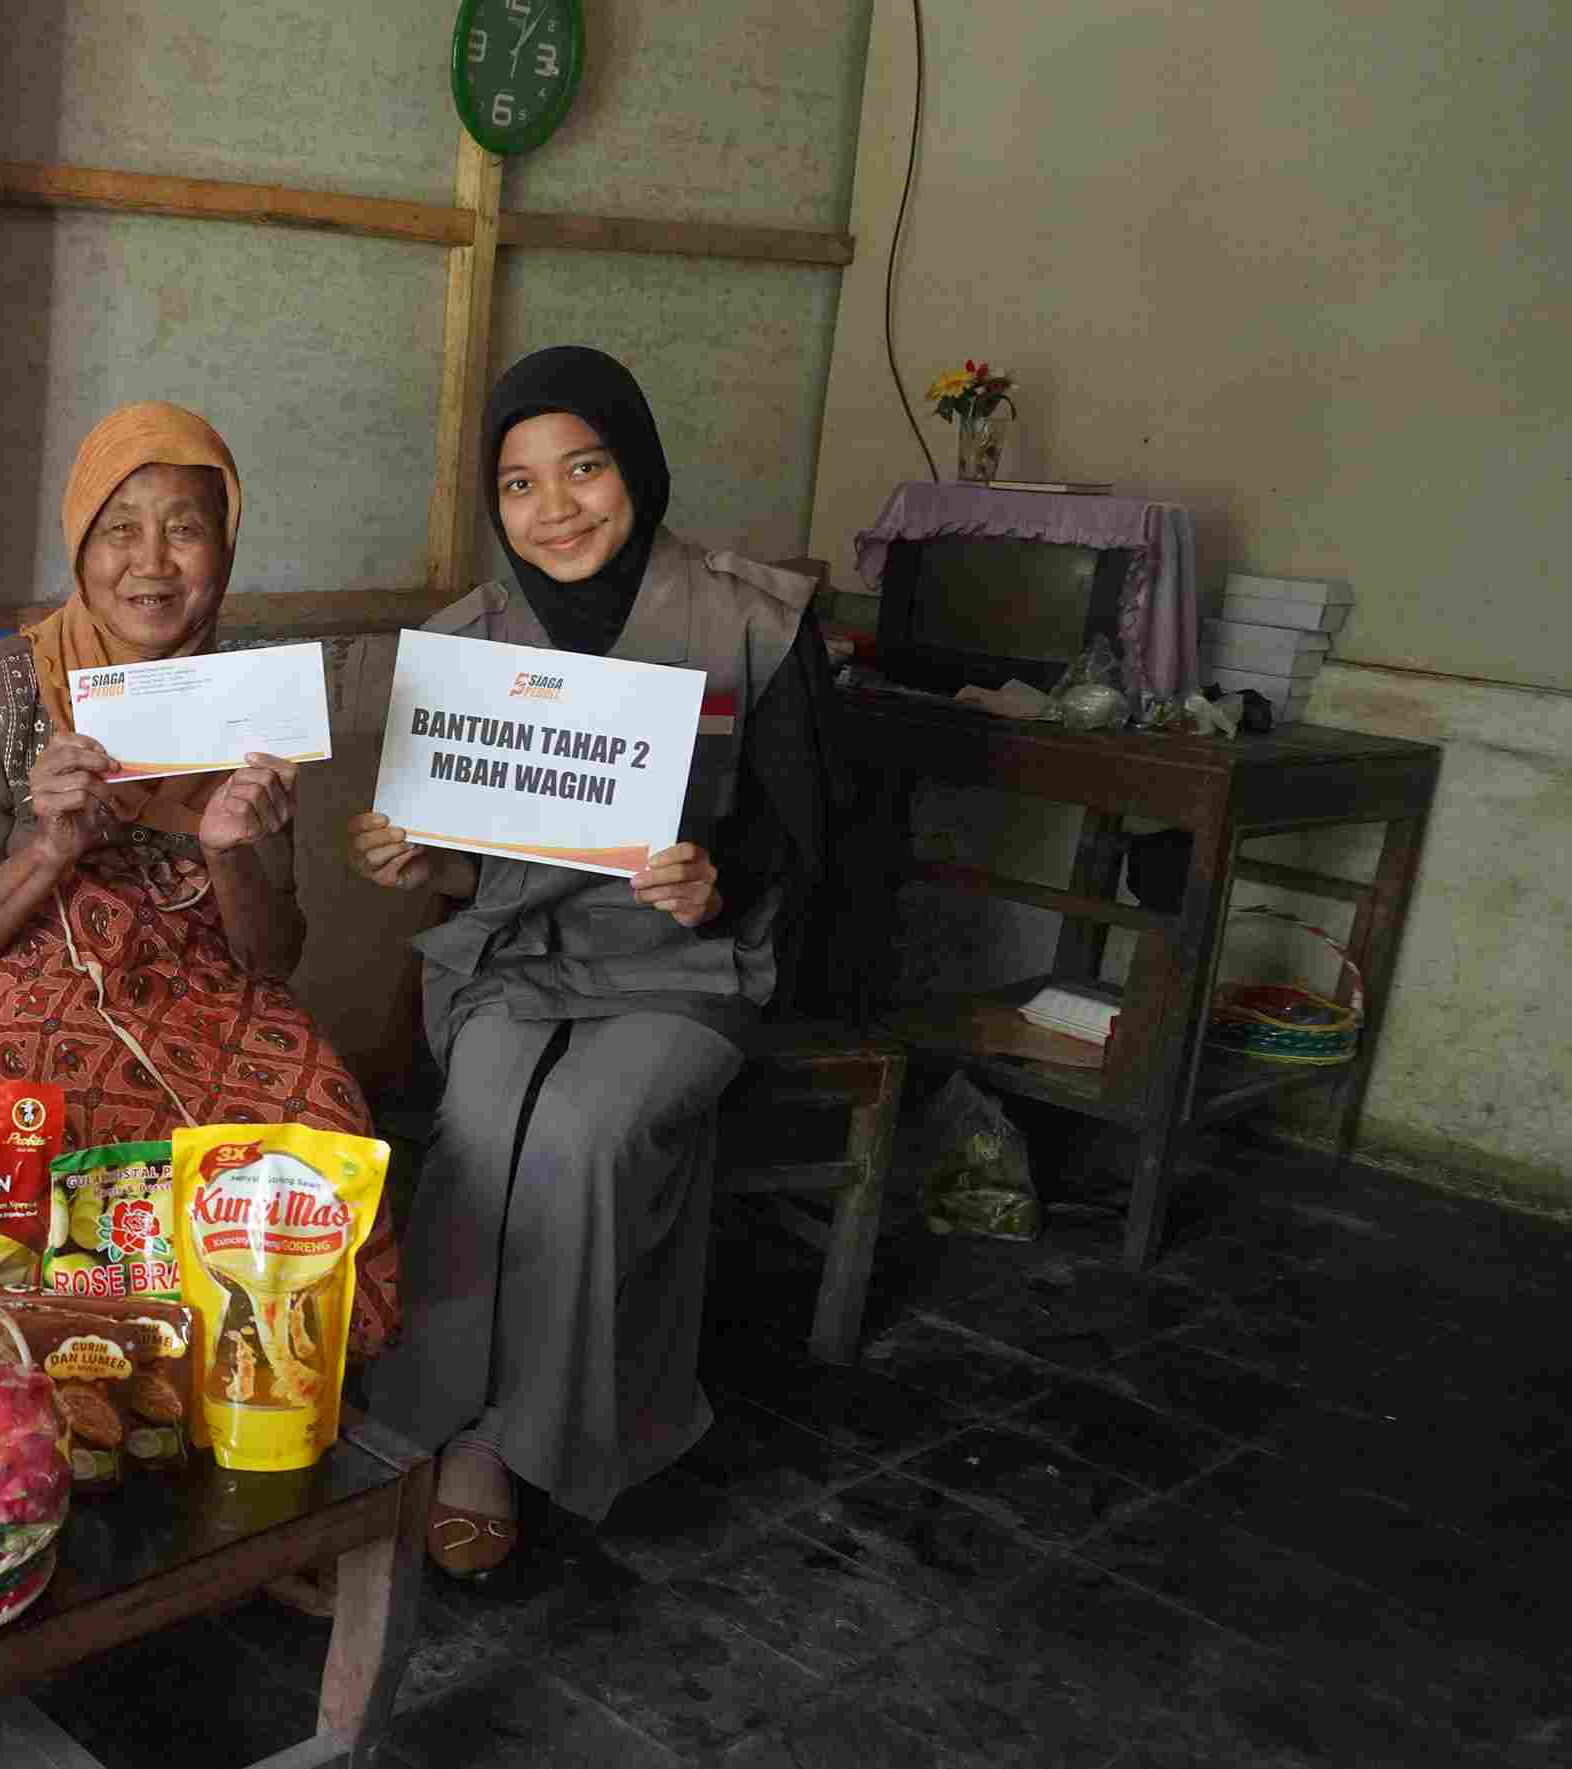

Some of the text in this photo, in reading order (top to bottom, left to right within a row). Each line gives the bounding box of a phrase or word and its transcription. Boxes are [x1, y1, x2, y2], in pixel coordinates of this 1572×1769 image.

[492, 93, 515, 127] 6
[92, 671, 124, 688] SIAGA
[528, 674, 564, 689] SIAGA
[411, 707, 651, 768] BANTUAN TAHAP 2
[429, 752, 616, 806] MBAH WAGINI
[193, 1186, 351, 1228] Kuni Mas
[53, 1260, 181, 1297] ROSE BRA
[50, 1353, 78, 1366] DAN
